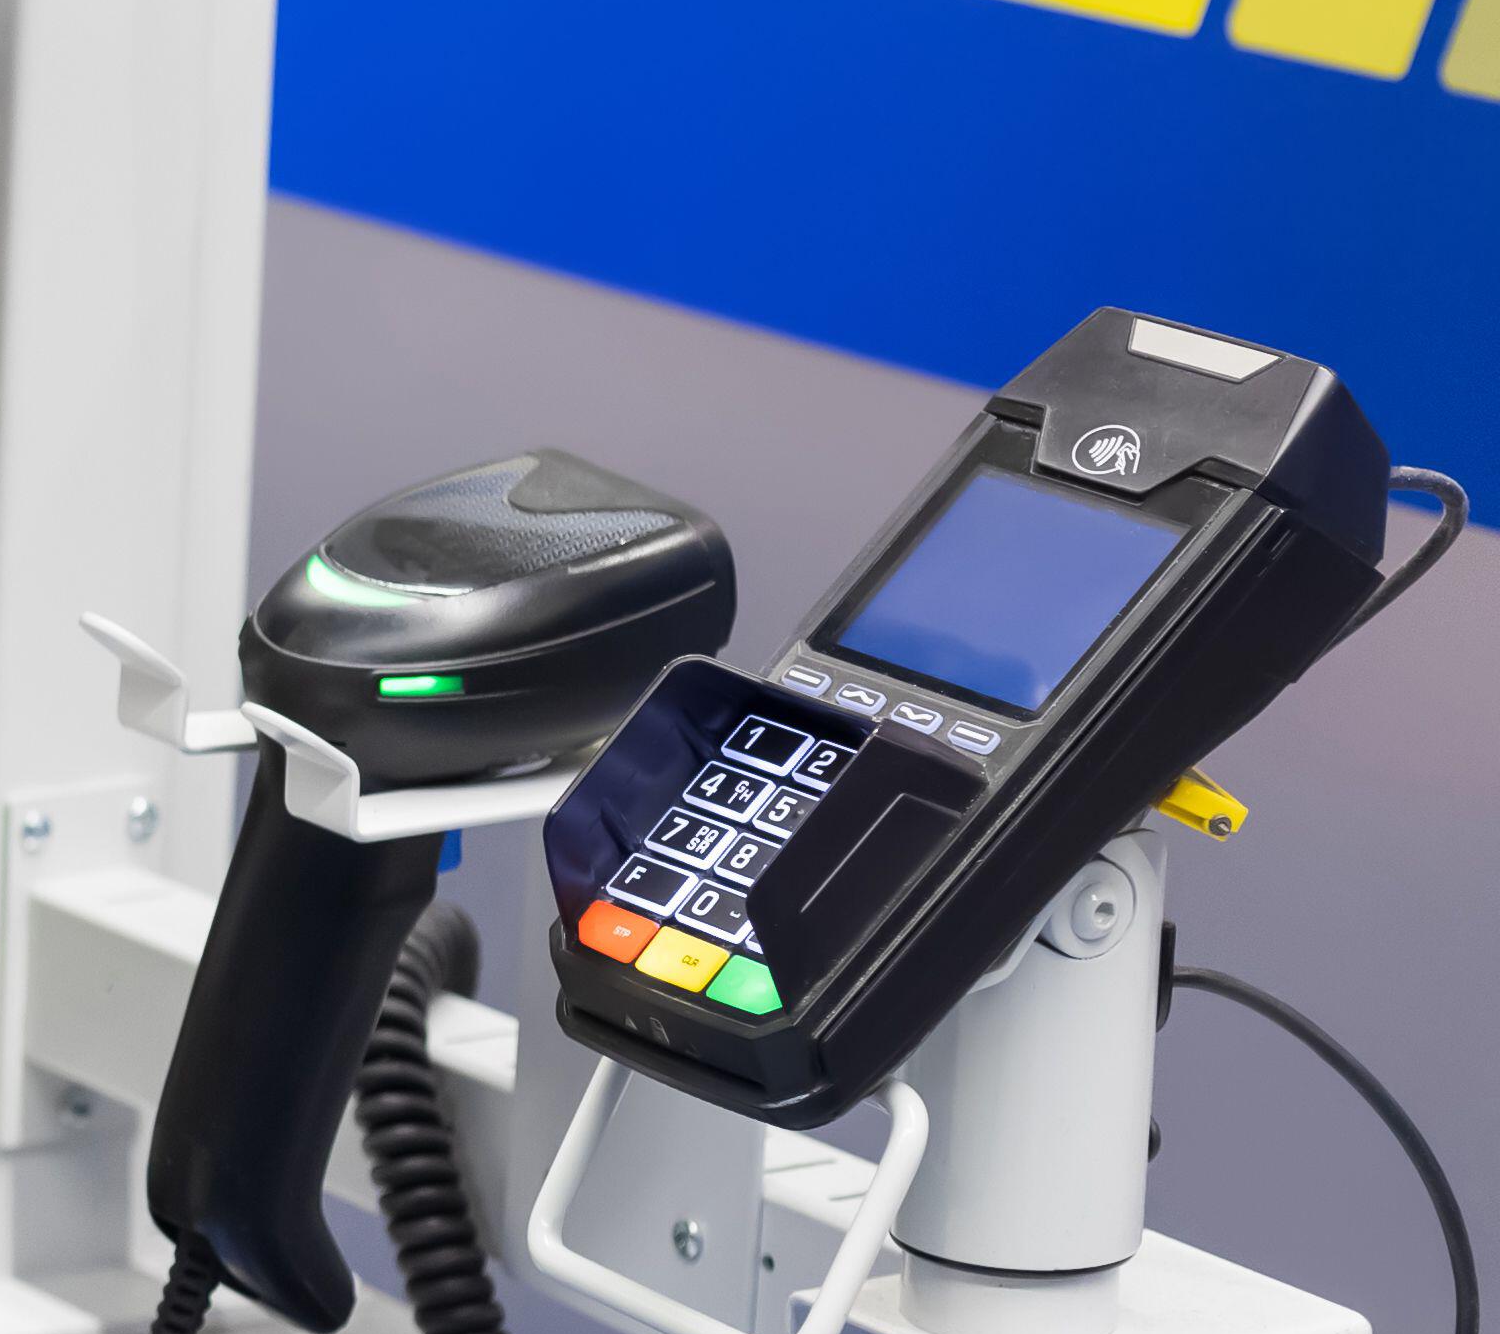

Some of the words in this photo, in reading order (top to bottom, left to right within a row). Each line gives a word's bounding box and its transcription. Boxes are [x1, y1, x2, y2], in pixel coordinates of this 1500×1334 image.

[744, 725, 766, 750] 1
[807, 750, 838, 776] 2
[700, 773, 727, 797] 4
[768, 795, 798, 822] 5
[661, 816, 690, 842] 7
[730, 843, 759, 870] 8
[624, 865, 648, 885] F
[691, 890, 720, 917] 0
